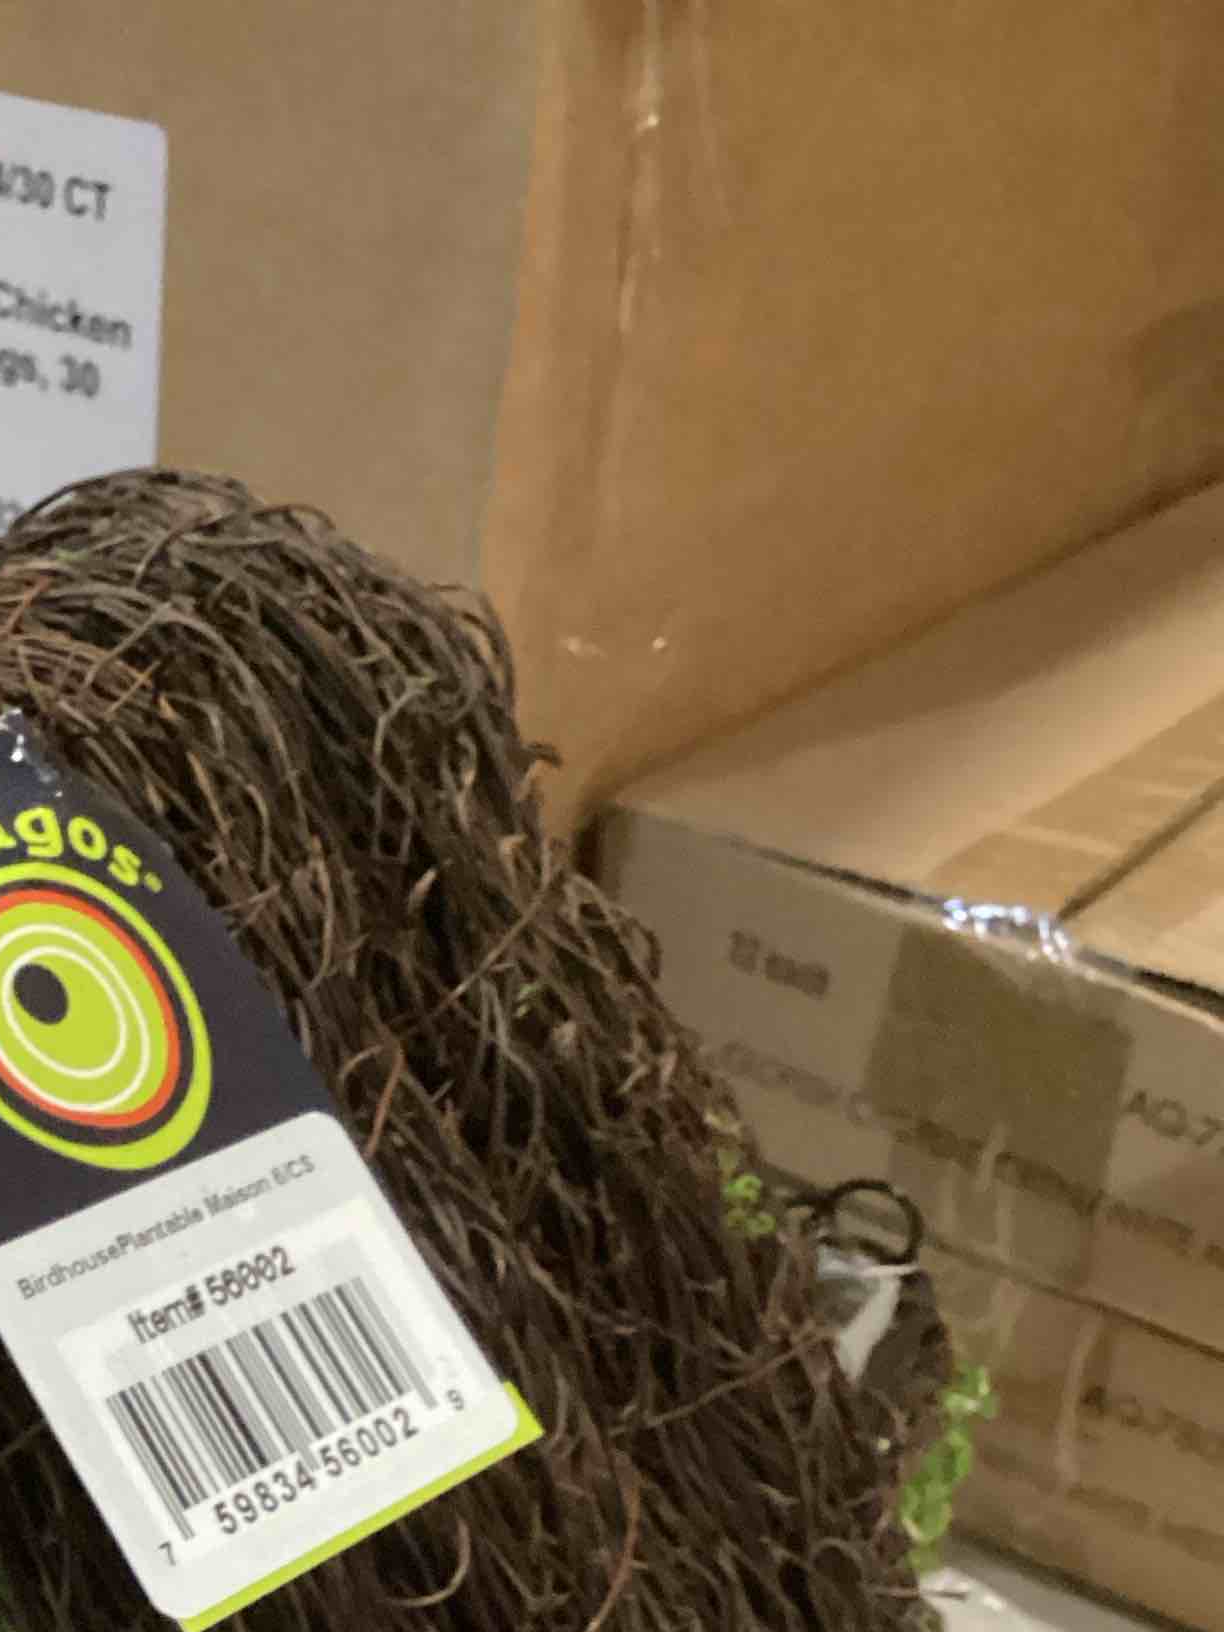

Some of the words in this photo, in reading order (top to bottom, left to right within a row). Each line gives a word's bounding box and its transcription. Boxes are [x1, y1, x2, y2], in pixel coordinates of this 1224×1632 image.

[63, 176, 110, 220] CT
[60, 353, 100, 398] 30
[17, 1206, 203, 1300] BirdhousePlantable
[204, 1177, 272, 1218] Maison
[128, 1284, 205, 1344] Item#
[159, 1541, 177, 1567] 7
[213, 1460, 317, 1535] 59834
[318, 1407, 419, 1478] 56002
